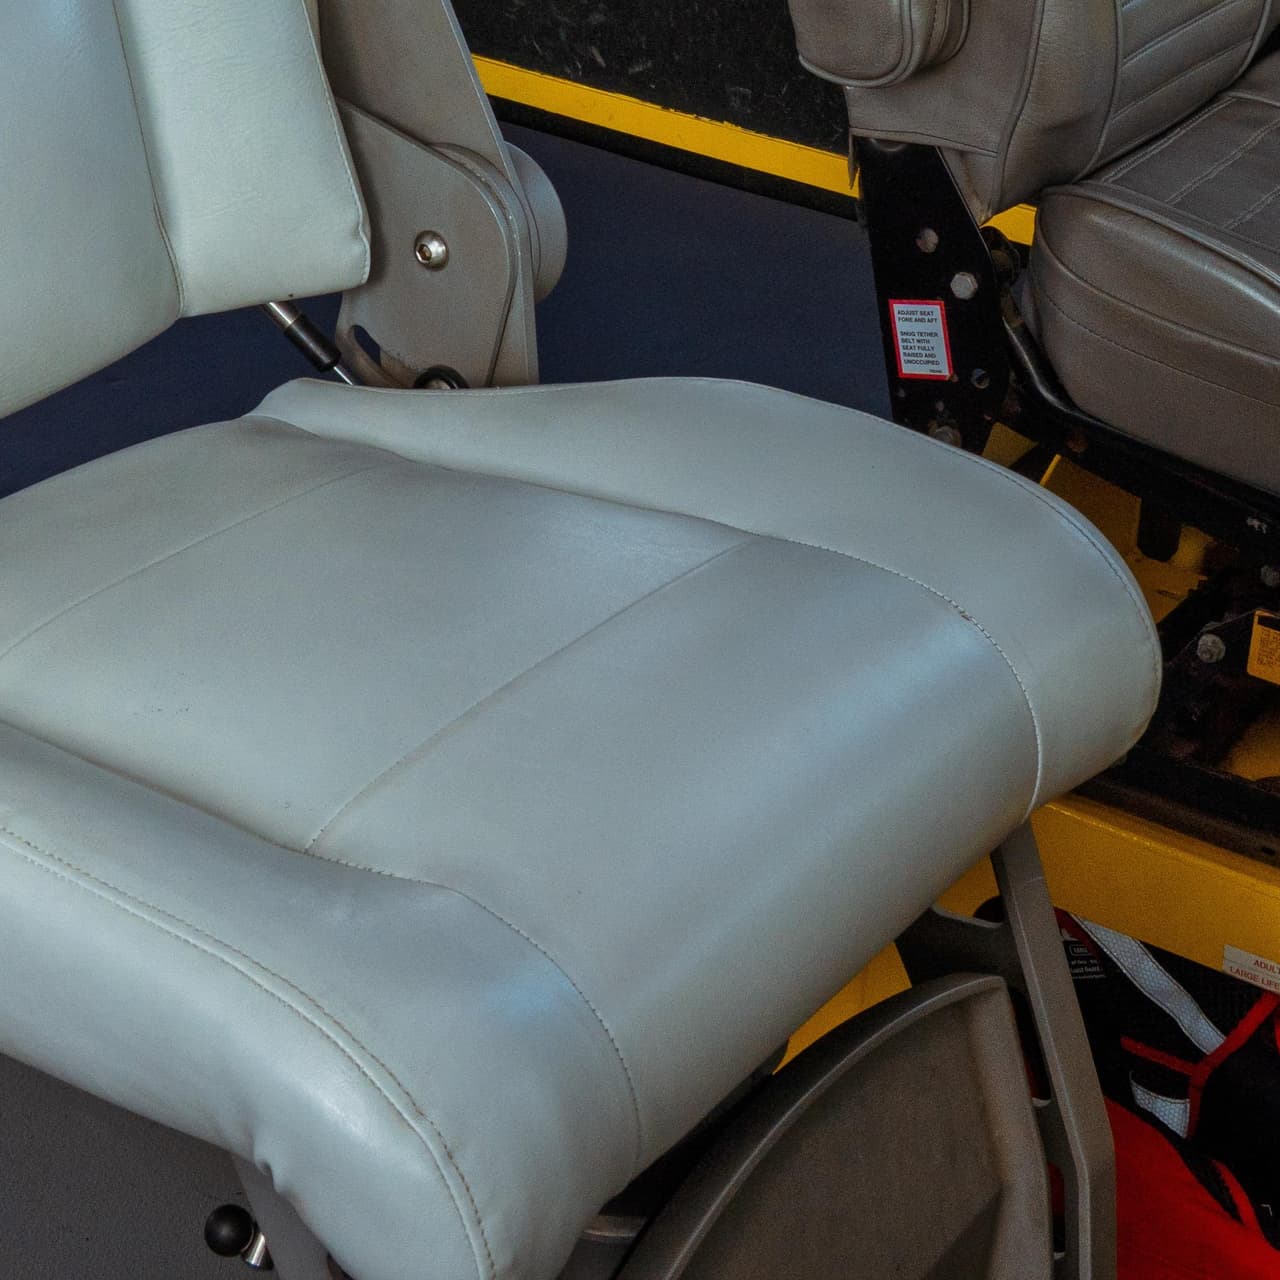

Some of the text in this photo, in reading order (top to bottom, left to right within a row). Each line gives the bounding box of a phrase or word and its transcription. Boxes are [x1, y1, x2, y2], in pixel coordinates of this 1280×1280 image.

[903, 358, 940, 366] UNOCCUPIED
[1229, 965, 1260, 983] LARGE
[1261, 977, 1280, 991] LIFE
